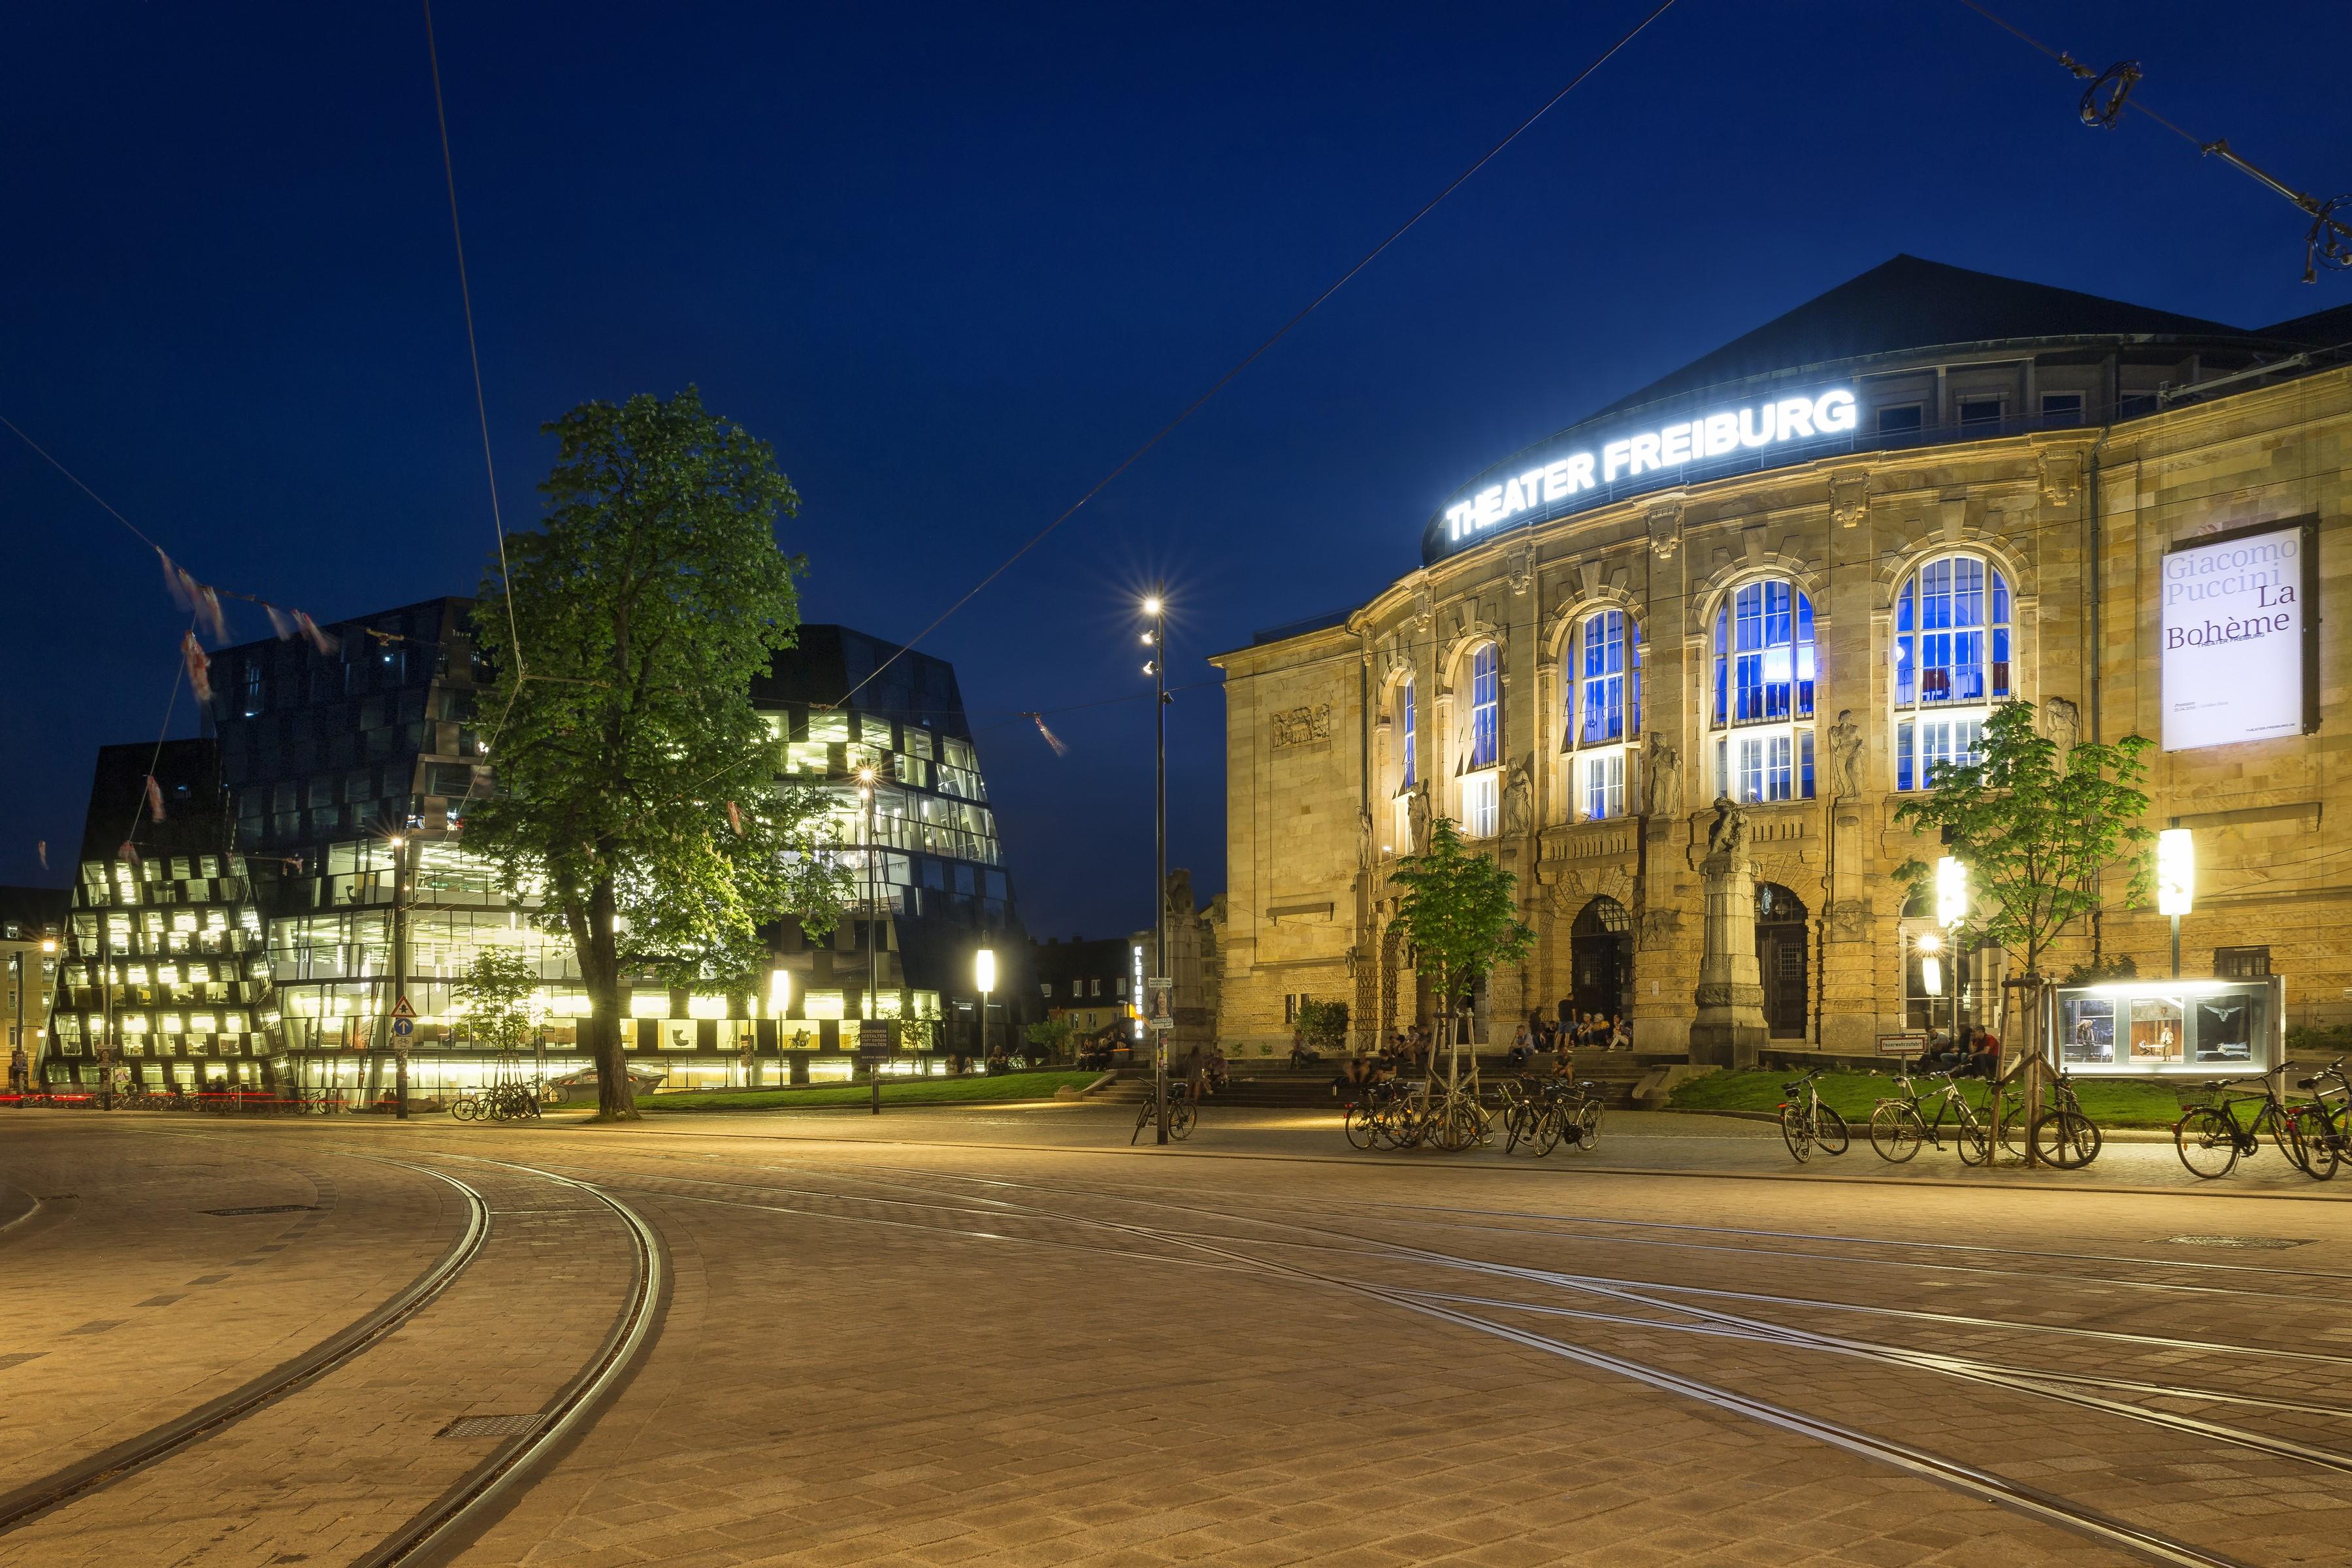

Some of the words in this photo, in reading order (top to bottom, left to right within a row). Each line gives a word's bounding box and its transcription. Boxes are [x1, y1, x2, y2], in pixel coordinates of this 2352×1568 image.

[1446, 453, 1595, 541] THEATER
[1604, 390, 1856, 482] FREIBURG
[2166, 539, 2297, 580] Giacomo
[2166, 562, 2282, 606] Puccini
[2257, 585, 2296, 608] La
[2166, 612, 2290, 649] Bohème
[2197, 638, 2229, 648] THEATER
[2230, 632, 2265, 643] FREIBURG
[1134, 946, 1143, 1015] KLEINES
